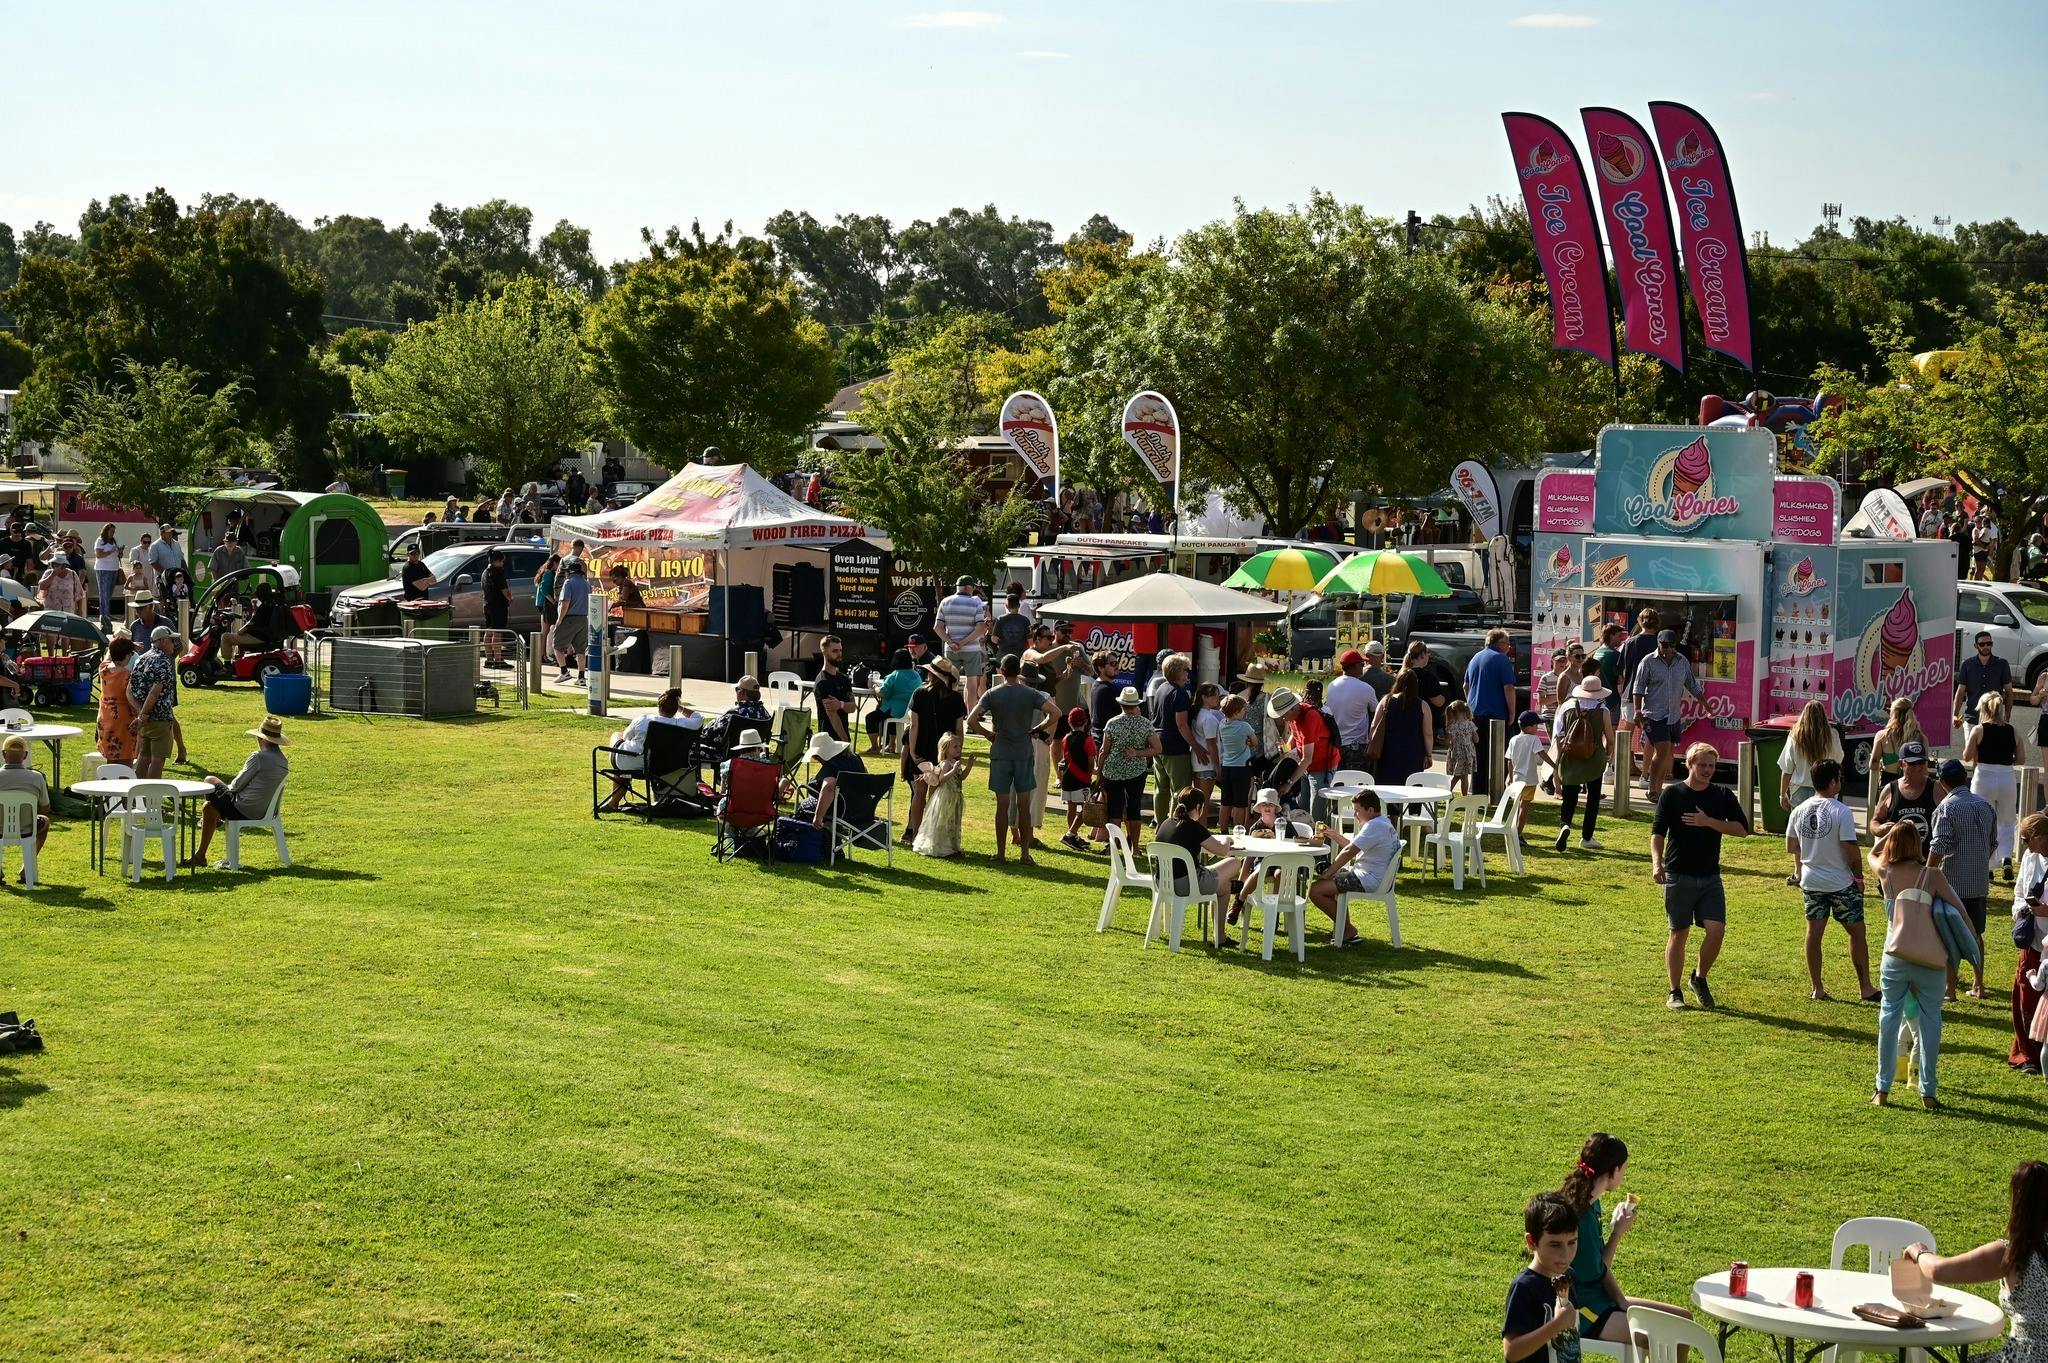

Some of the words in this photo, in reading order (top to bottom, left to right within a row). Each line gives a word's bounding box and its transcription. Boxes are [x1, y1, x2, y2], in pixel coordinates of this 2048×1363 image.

[1521, 166, 1546, 179] Cool
[1537, 183, 1571, 236] Ice
[1681, 176, 1714, 232] Ice
[1613, 191, 1657, 262] Cool
[1635, 257, 1667, 345] Cones
[1552, 240, 1584, 341] Cream
[1695, 237, 1730, 342] Cream
[1010, 426, 1050, 473] Pancakes
[1027, 430, 1050, 459] Dutch
[1132, 428, 1171, 478] Pancakes
[1150, 433, 1172, 462] Dutch
[1547, 494, 1590, 502] MILKSHAKES
[1780, 502, 1829, 510] MILKSHAKES
[1476, 500, 1496, 520] FM
[1624, 494, 1675, 527] Cool
[1675, 491, 1740, 520] Cones
[1546, 518, 1584, 527] HOTDOGS
[1778, 514, 1817, 523] SLUSHIES
[648, 528, 674, 542] PIZZA
[752, 527, 787, 540] WOOD
[790, 525, 826, 538] FIRED
[829, 525, 866, 538] PIZZA
[1778, 528, 1822, 537] HOTDOGS
[1105, 538, 1148, 547] PANCAKES
[834, 554, 855, 564] Oven
[856, 555, 881, 565] Lovin'
[850, 566, 864, 574] Fired
[891, 576, 923, 587] Wood
[1780, 583, 1800, 596] Cool
[1800, 578, 1826, 592] Cones
[836, 621, 844, 629] The
[1085, 627, 1135, 653] Dutch
[1833, 680, 1886, 722] Cool
